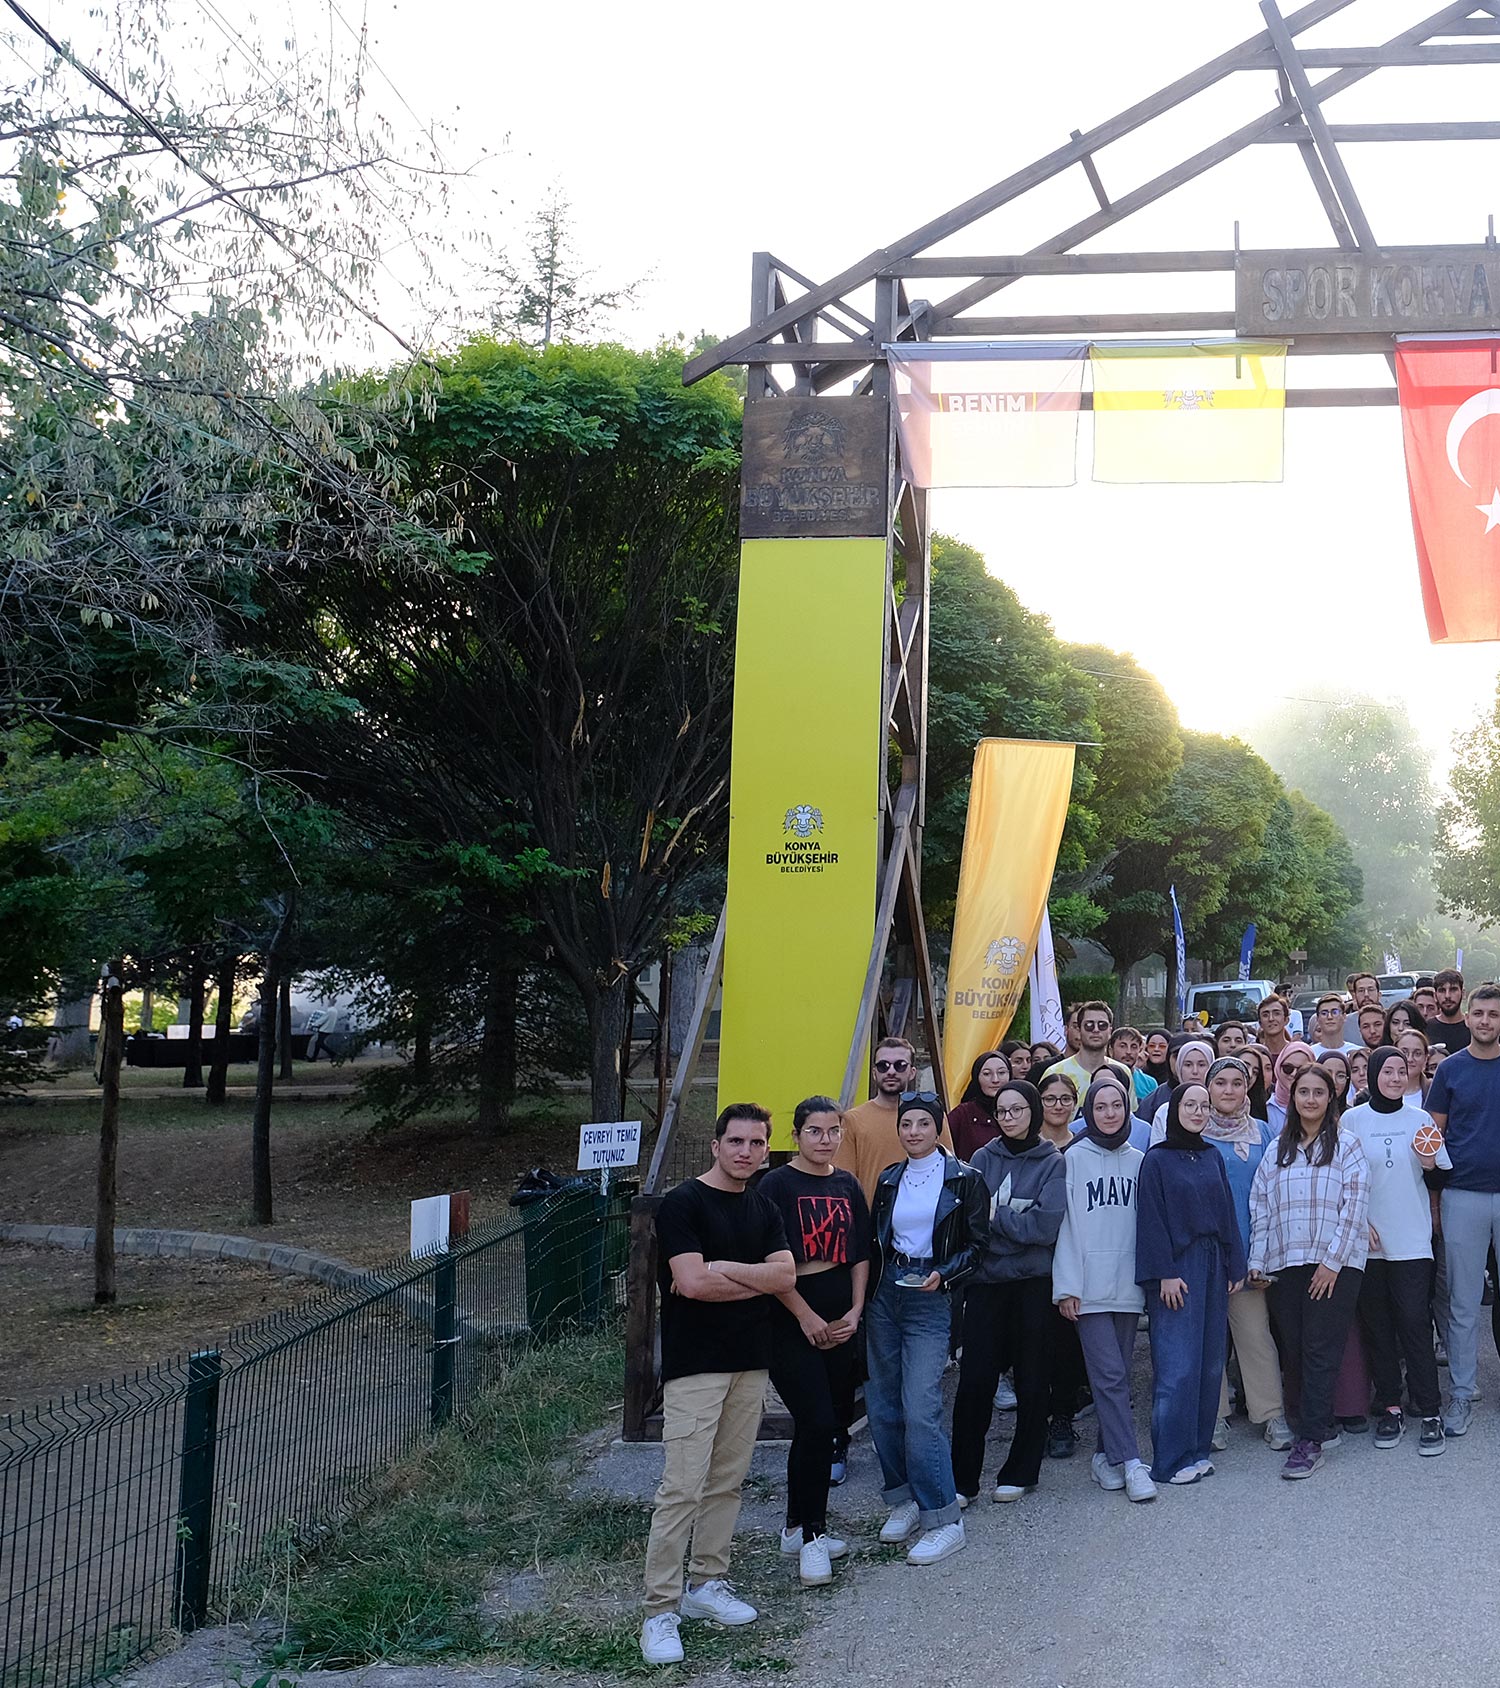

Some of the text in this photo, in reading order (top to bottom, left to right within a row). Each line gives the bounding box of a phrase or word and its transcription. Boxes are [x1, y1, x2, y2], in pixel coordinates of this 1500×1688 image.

[1261, 266, 1359, 321] SPOR
[1368, 263, 1491, 318] KONYA
[780, 466, 849, 483] KONYA
[784, 842, 821, 851] KONYA
[766, 851, 839, 866] BÜYÜKŞEHİR
[780, 864, 824, 873] BELEDİYESİ
[583, 1125, 638, 1148] ÇEVREYİ TEMİZ
[592, 1148, 626, 1164] TUTUNUZ
